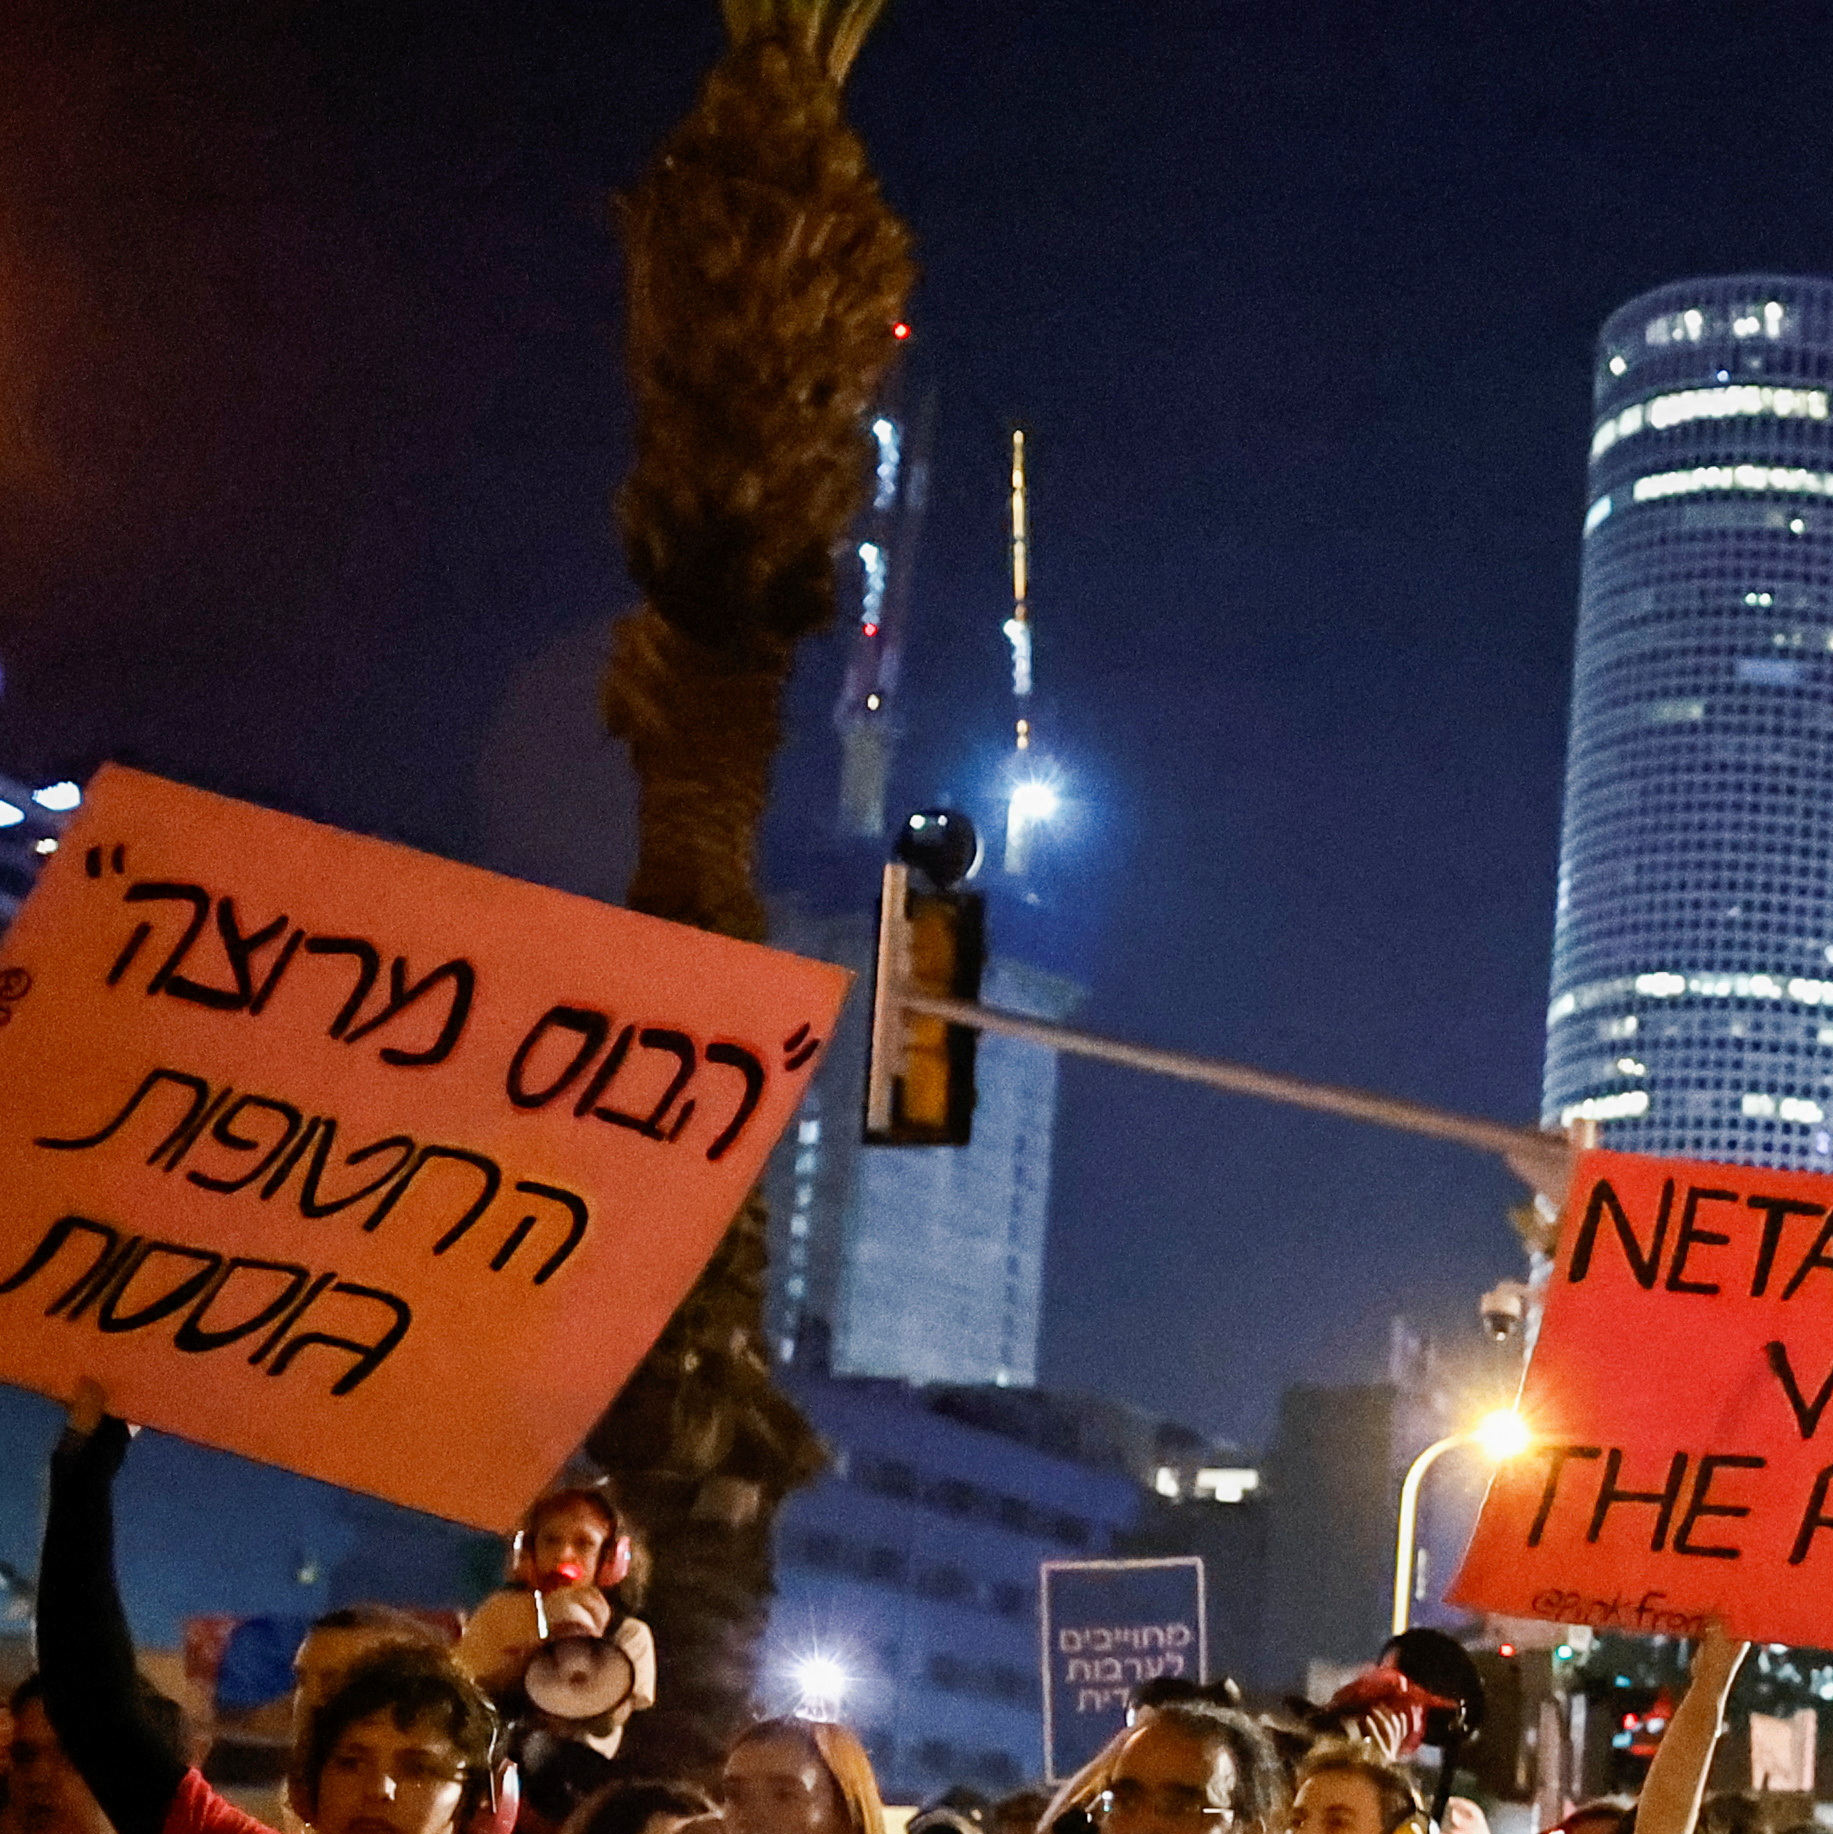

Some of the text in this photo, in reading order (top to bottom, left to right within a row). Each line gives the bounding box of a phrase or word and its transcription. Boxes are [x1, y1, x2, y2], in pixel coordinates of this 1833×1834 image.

[34, 1066, 589, 1286] החטופות
[0, 1214, 413, 1397] גוססות
[1527, 1445, 1766, 1561] THE
